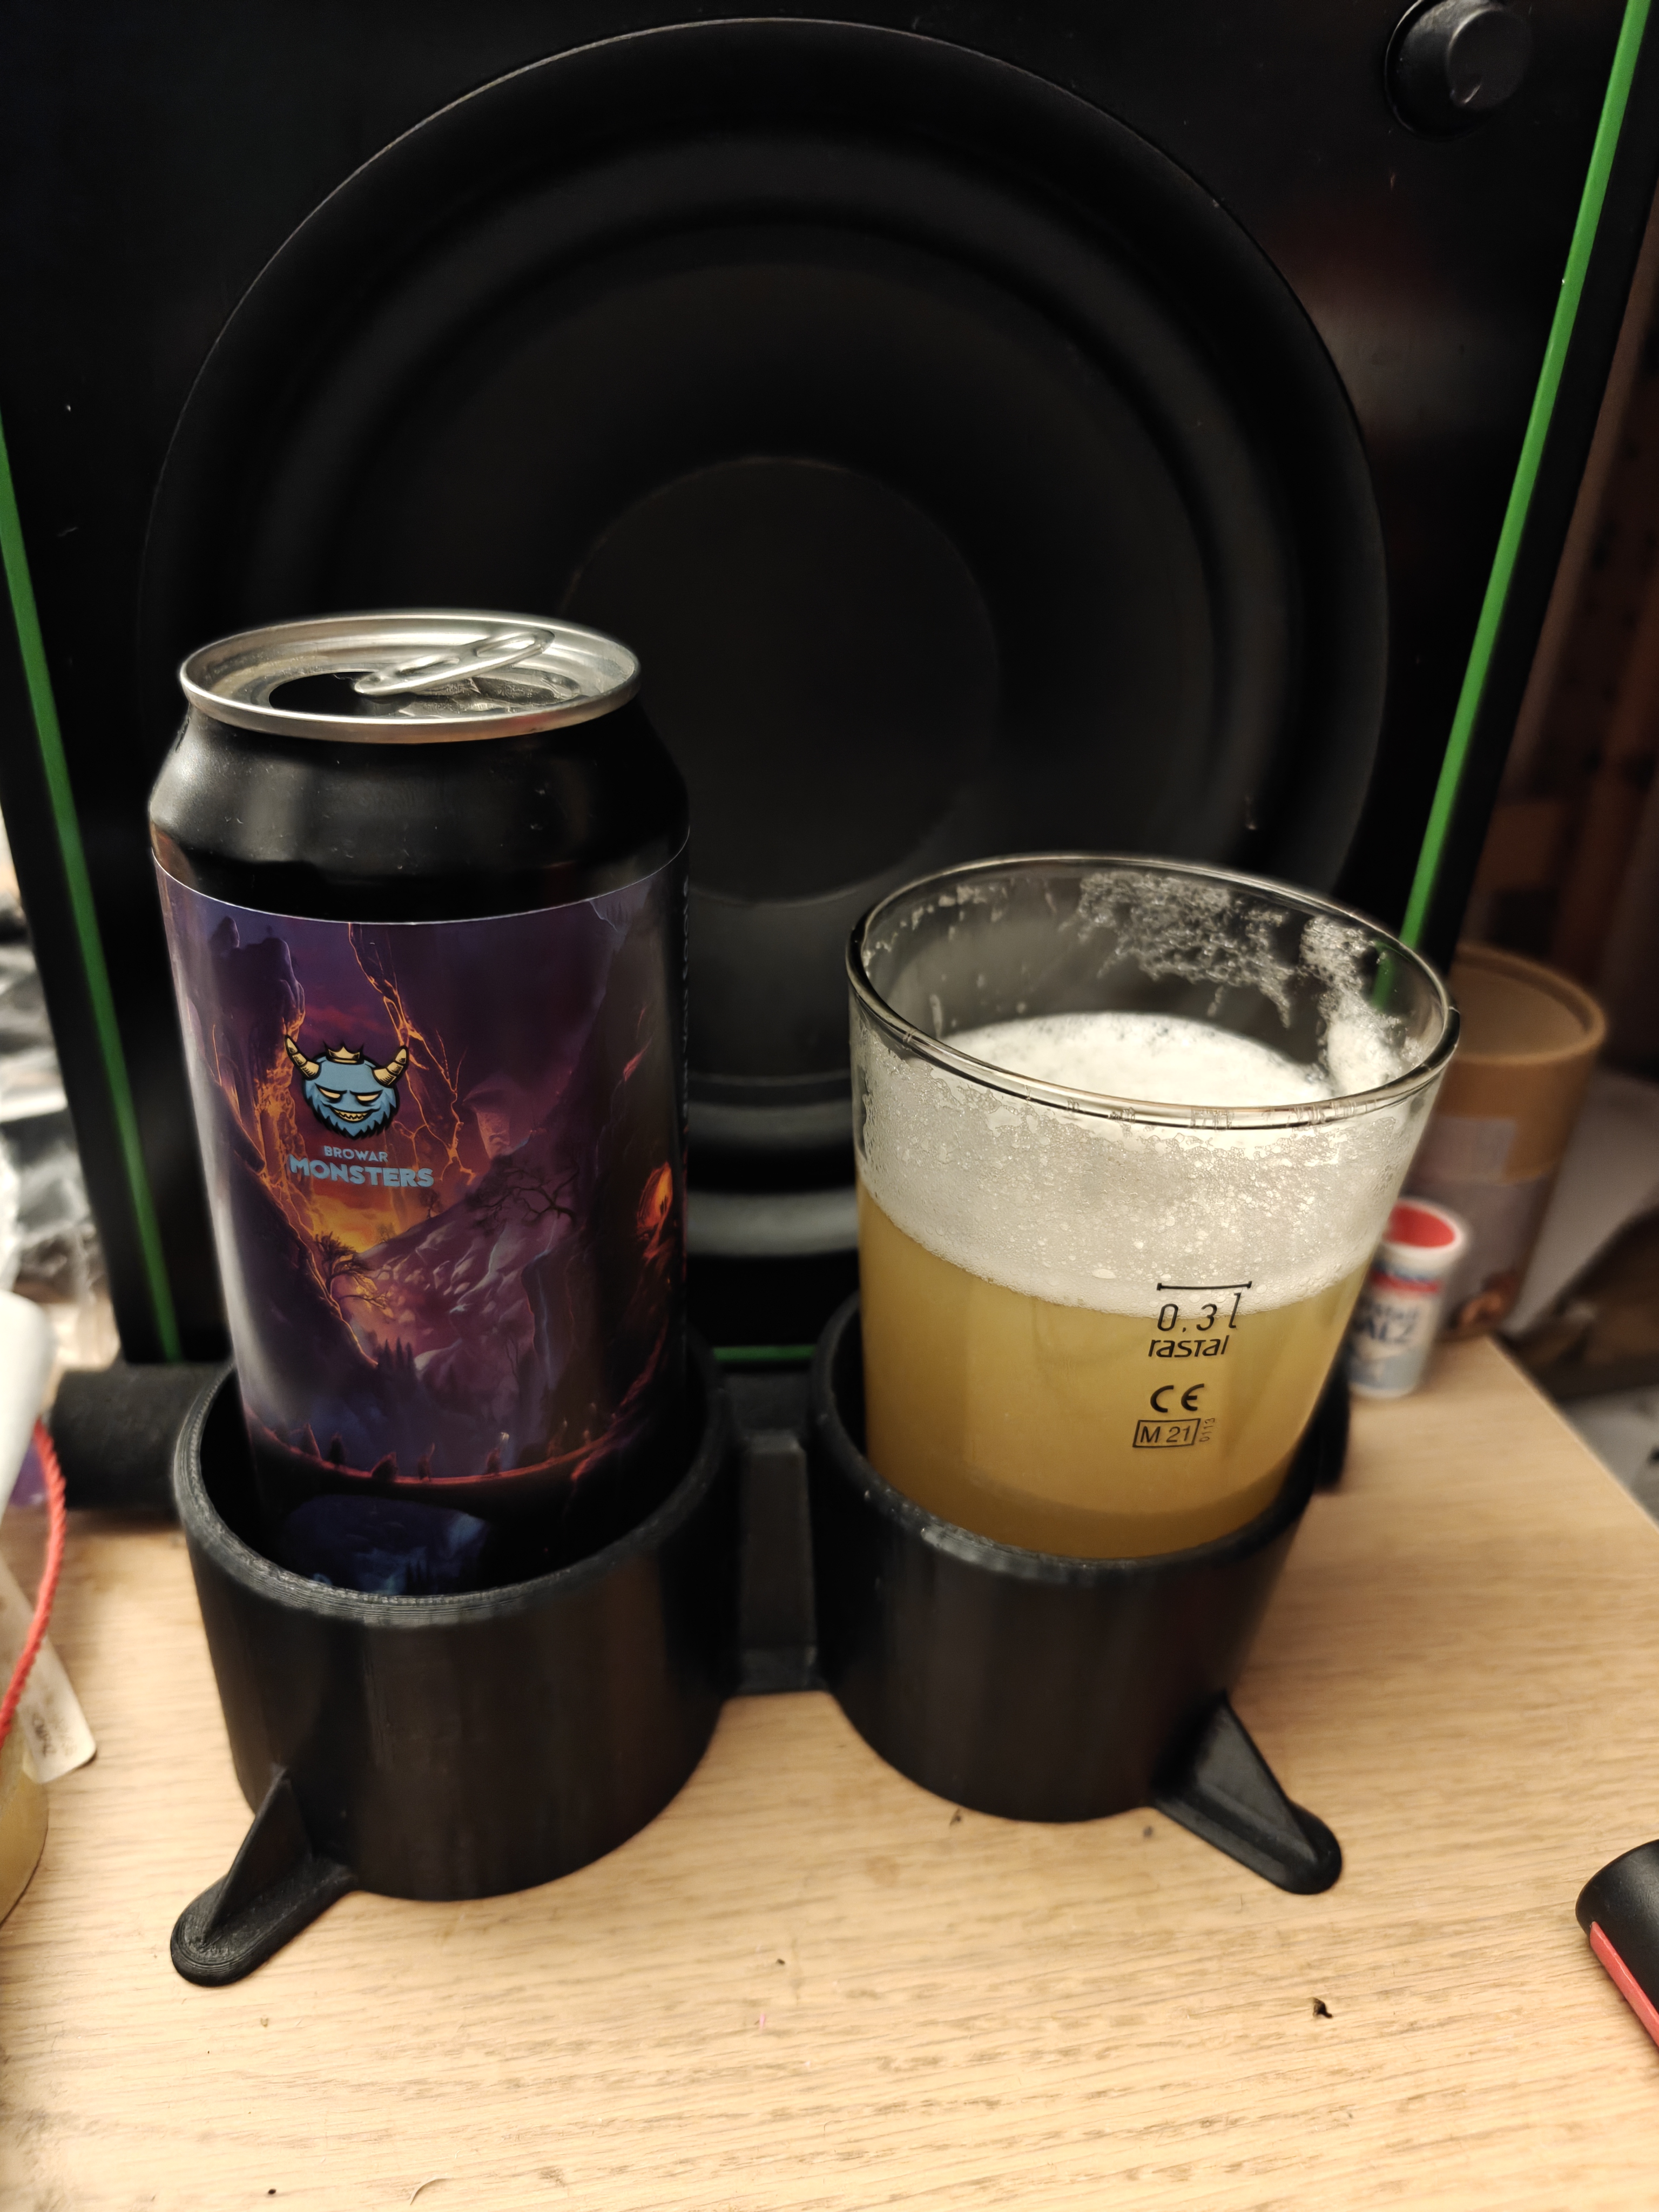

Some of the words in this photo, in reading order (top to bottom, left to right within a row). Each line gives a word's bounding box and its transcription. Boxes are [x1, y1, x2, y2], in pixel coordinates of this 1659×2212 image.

[324, 1145, 388, 1163] BROWAR
[289, 1154, 434, 1188] MONSTERS
[1148, 1334, 1230, 1358] rastal
[1150, 1383, 1205, 1413] CE
